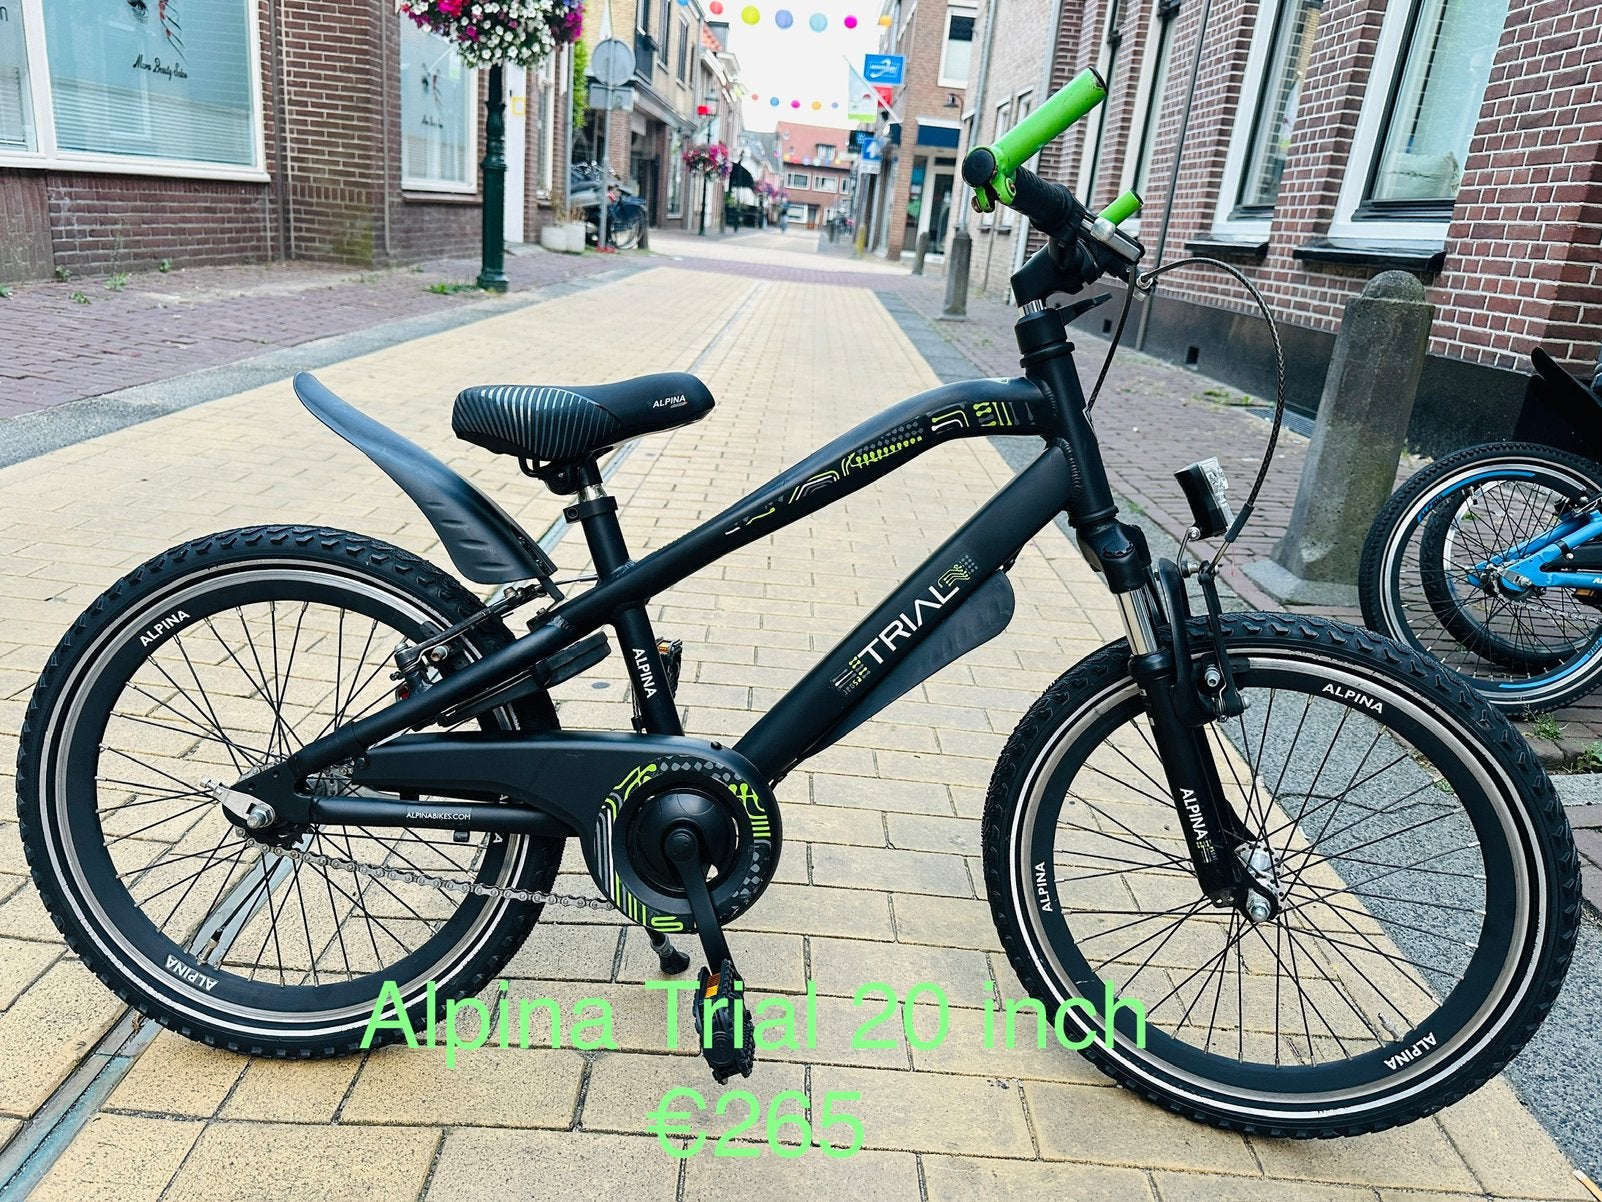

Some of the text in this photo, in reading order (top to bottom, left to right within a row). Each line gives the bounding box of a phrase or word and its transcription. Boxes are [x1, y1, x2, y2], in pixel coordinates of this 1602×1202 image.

[652, 394, 686, 409] ALPINA
[140, 610, 191, 647] ALPINA
[857, 585, 960, 665] TRIAL
[632, 648, 657, 699] ALPINA
[1321, 683, 1383, 714] ALPINA
[406, 811, 471, 821] ALPINABIKES.COM
[1179, 788, 1209, 841] ALPINA
[1034, 861, 1053, 912] ALPINA
[165, 953, 219, 991] ALPINA
[1383, 1031, 1437, 1070] ALPINA
